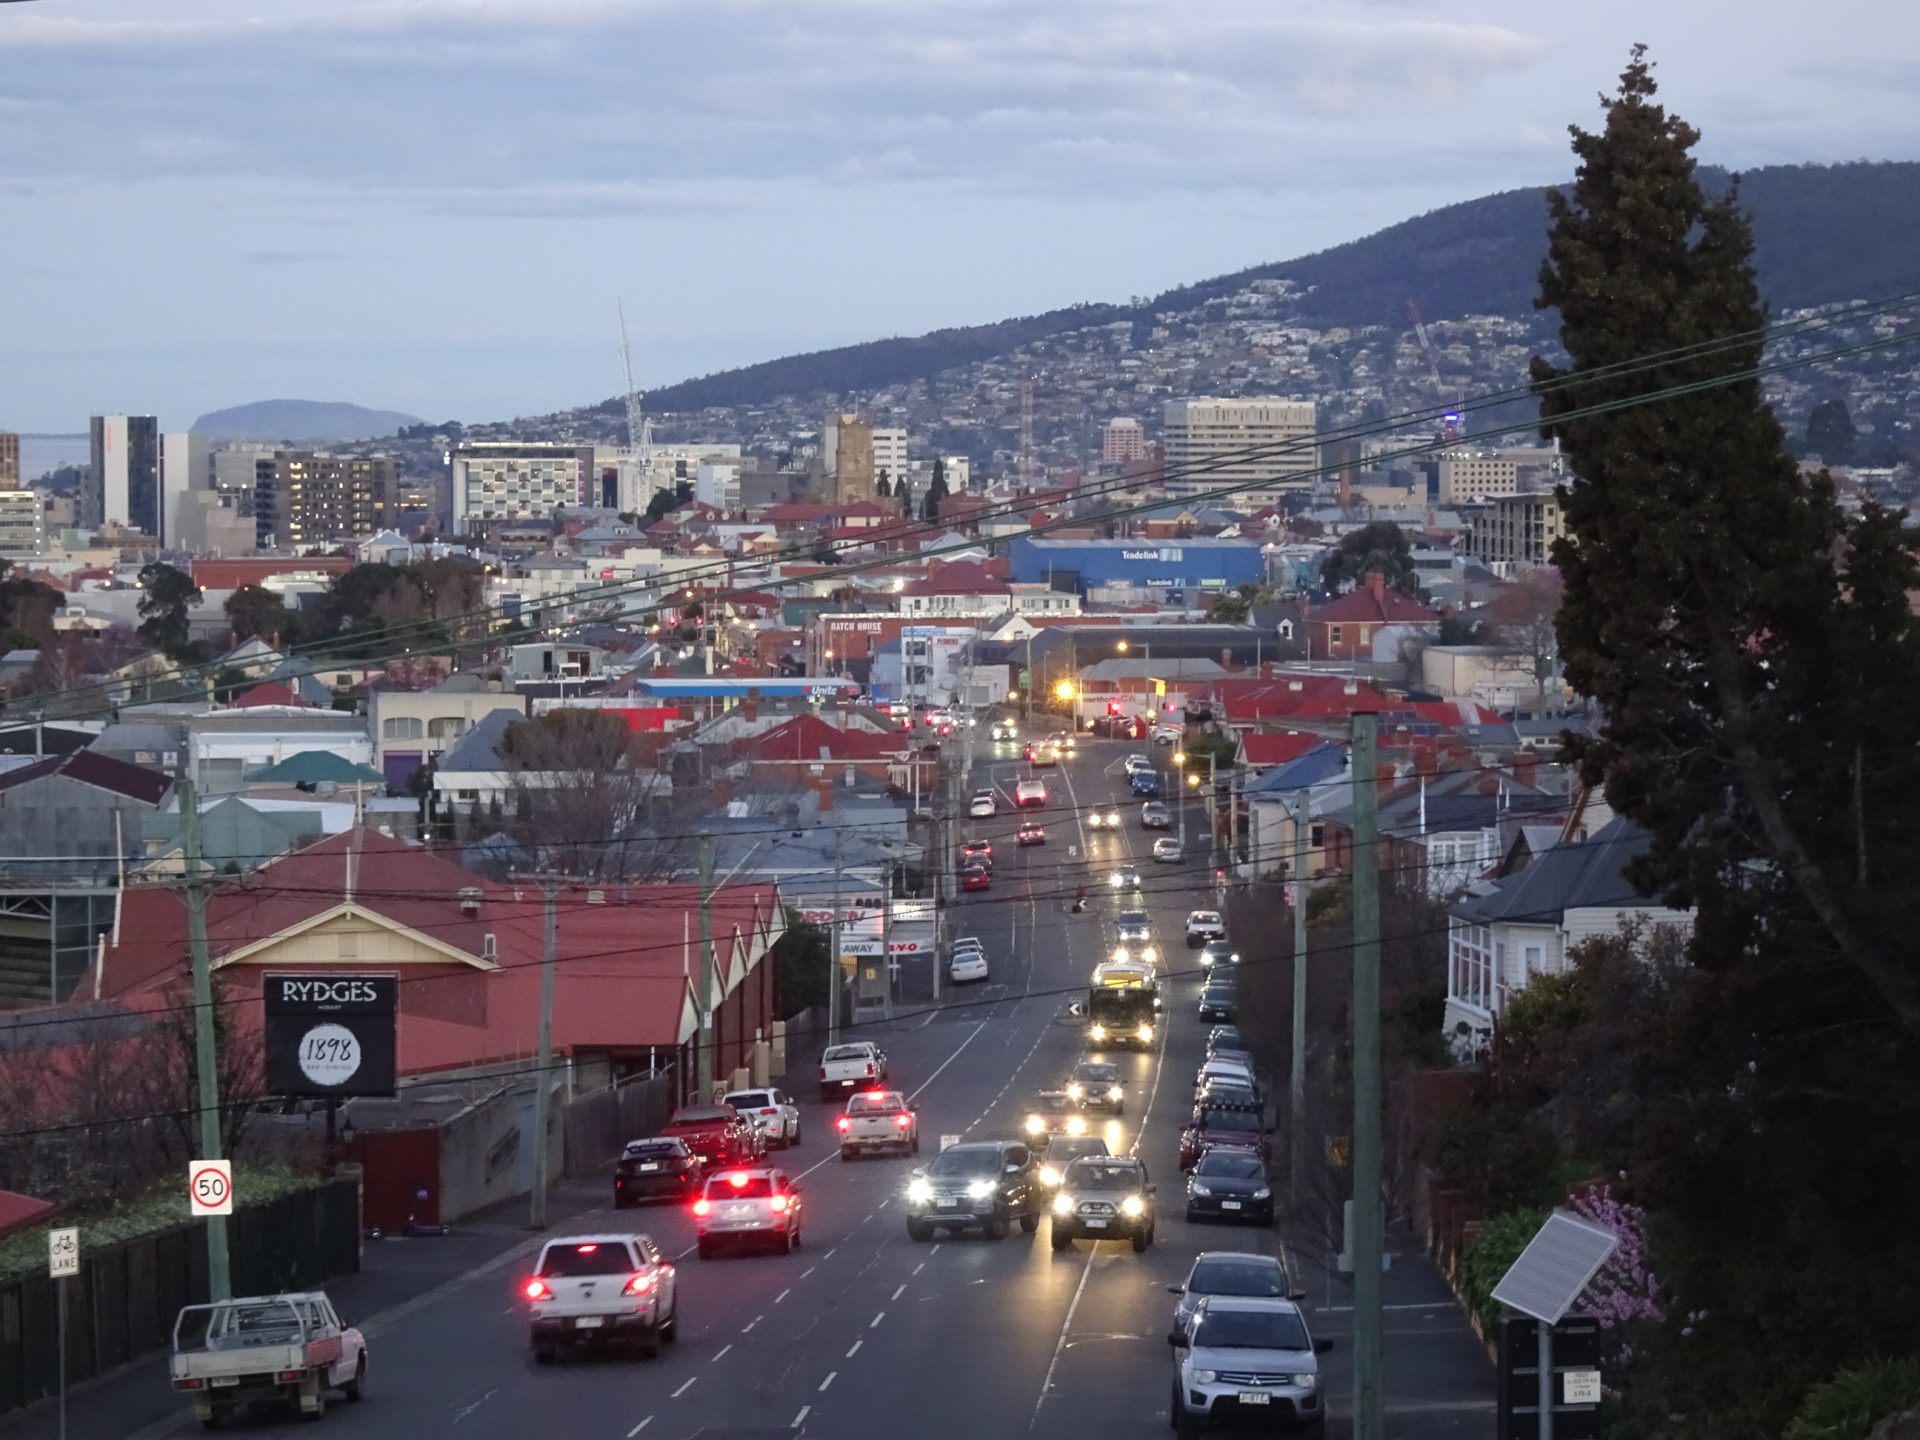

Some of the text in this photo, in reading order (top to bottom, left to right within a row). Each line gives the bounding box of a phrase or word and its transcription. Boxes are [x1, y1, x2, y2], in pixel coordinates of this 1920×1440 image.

[1122, 550, 1159, 560] Tradelink
[857, 622, 882, 631] HOUSE
[282, 981, 378, 1002] RYDGES
[307, 1038, 352, 1063] 1898
[198, 1178, 224, 1197] 50
[52, 1256, 76, 1271] LANE
